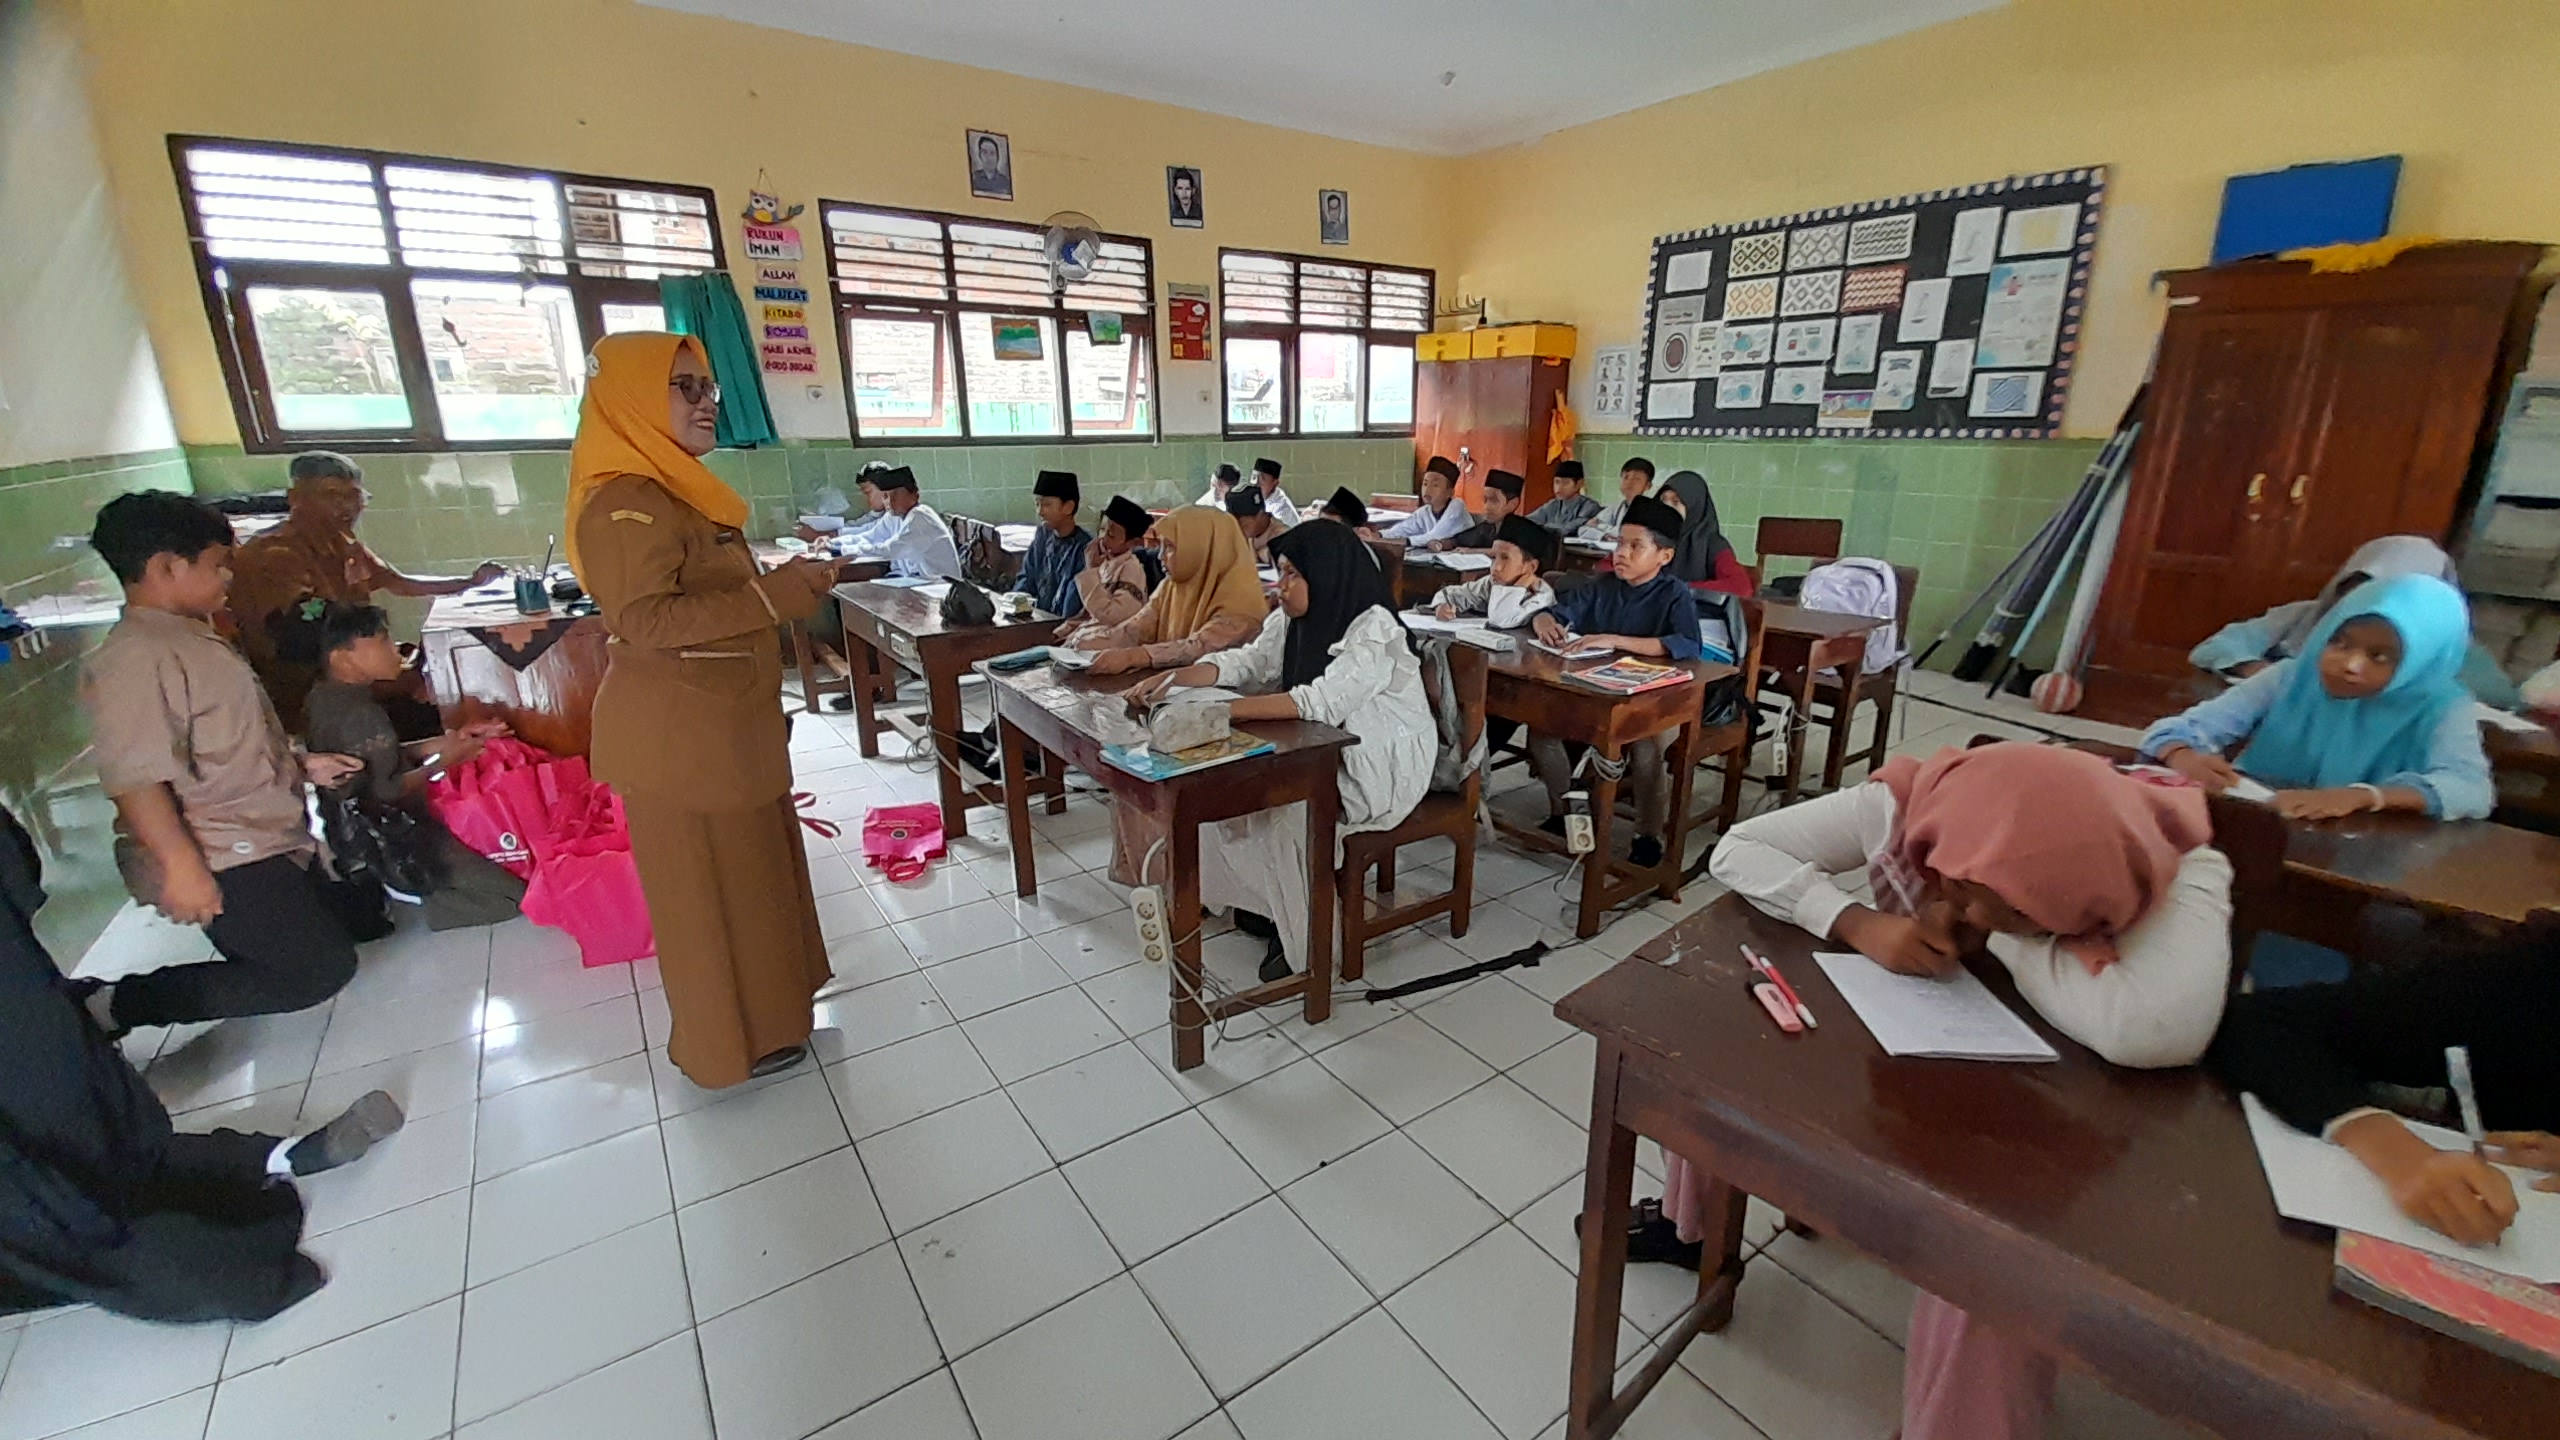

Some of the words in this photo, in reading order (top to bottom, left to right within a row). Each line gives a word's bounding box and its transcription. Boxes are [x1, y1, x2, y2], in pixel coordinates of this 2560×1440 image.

[746, 226, 785, 241] RUKUN
[749, 239, 780, 256] IMAN
[762, 267, 796, 280] ALLAH
